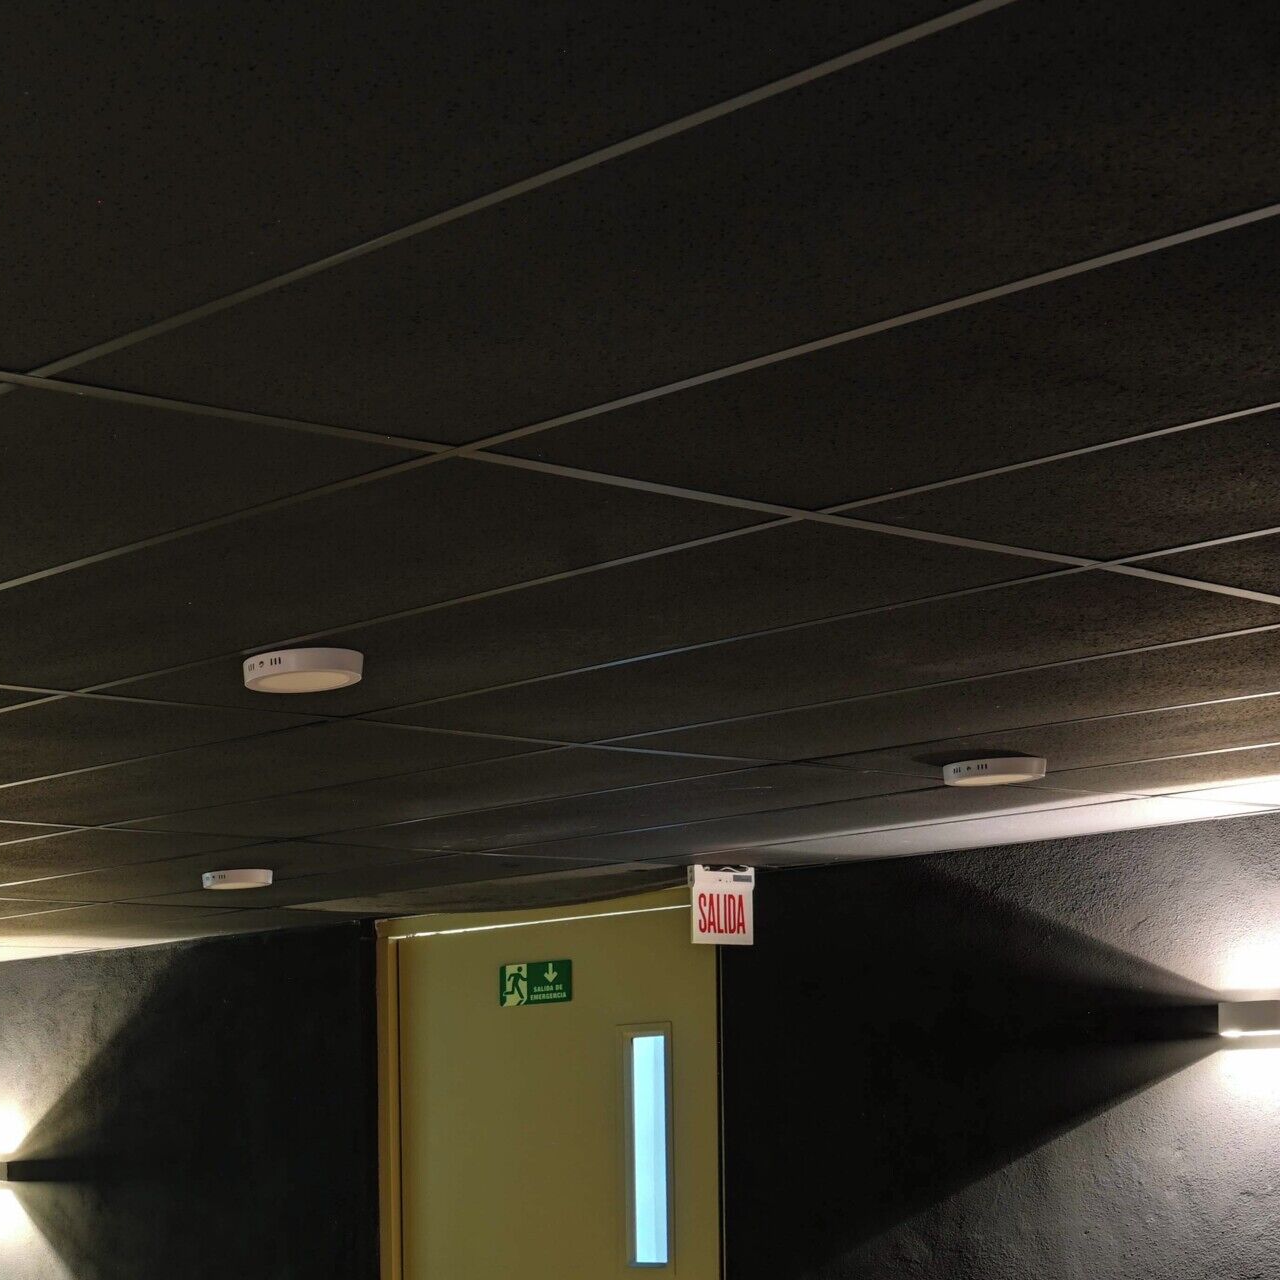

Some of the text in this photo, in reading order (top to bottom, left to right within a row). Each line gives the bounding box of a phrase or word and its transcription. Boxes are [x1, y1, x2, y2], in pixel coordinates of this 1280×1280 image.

[698, 893, 747, 935] SALIDA
[534, 985, 554, 993] SALIDA
[530, 992, 567, 1001] EMERGENCIA
